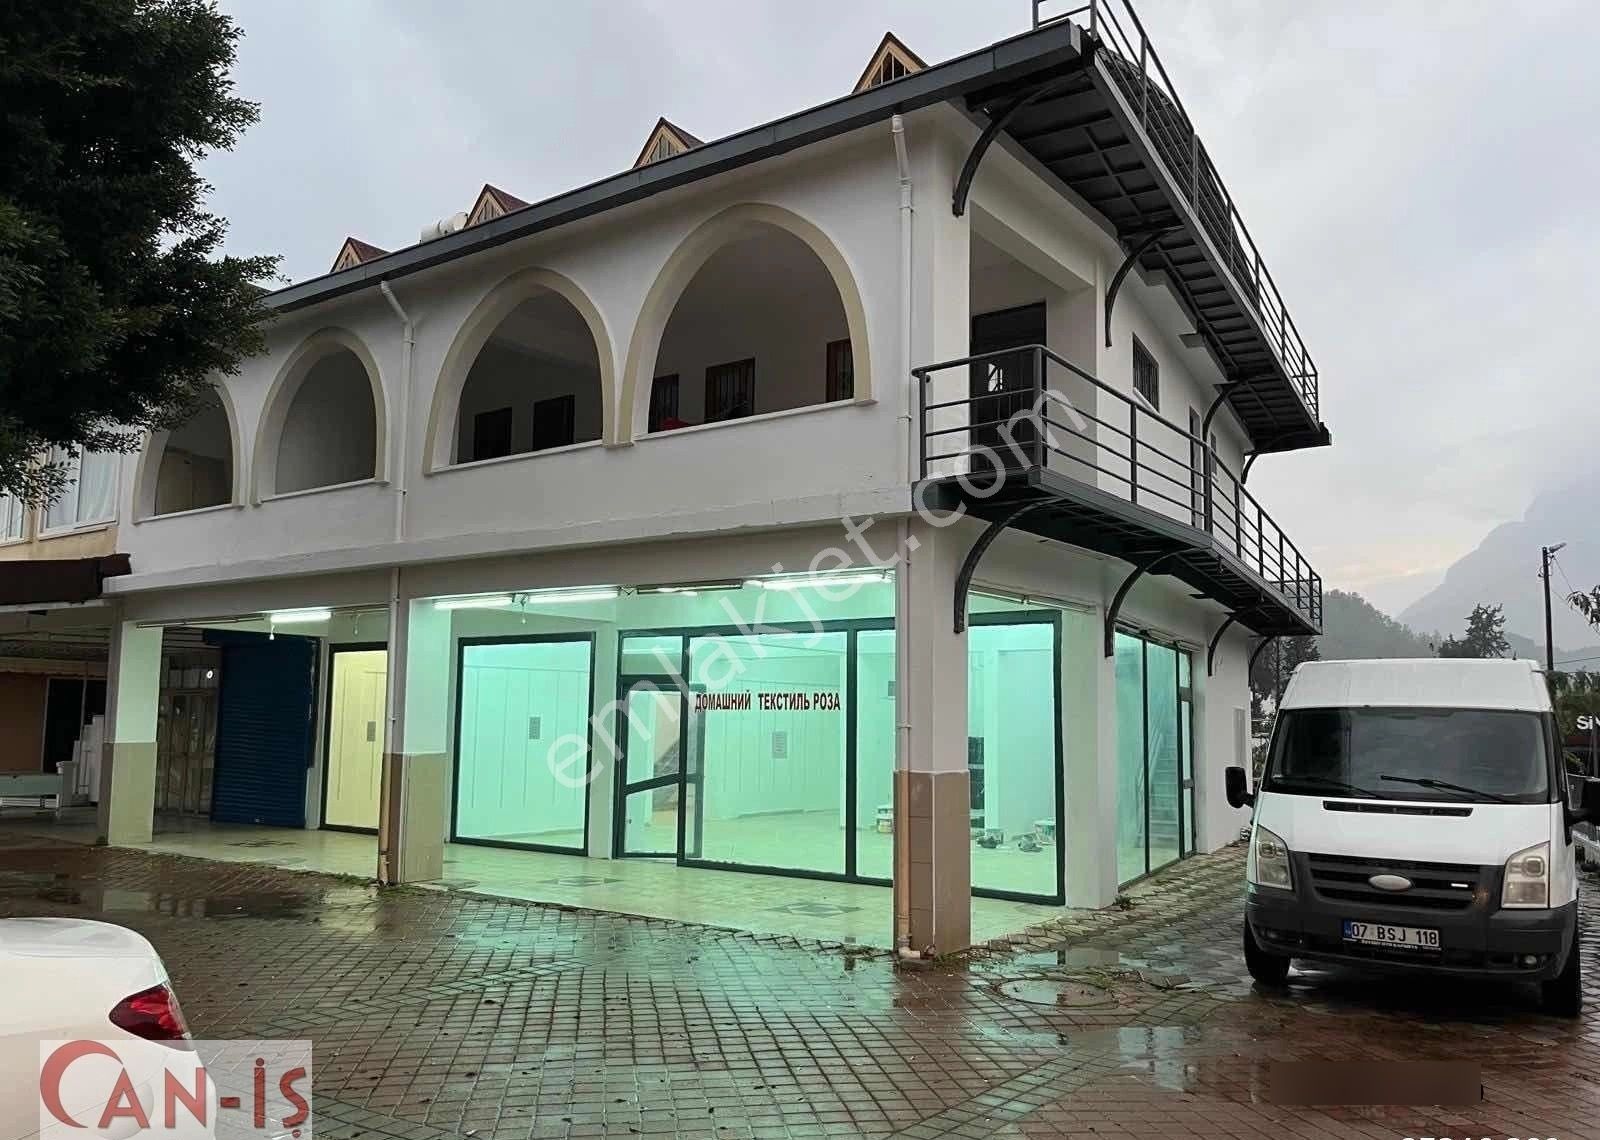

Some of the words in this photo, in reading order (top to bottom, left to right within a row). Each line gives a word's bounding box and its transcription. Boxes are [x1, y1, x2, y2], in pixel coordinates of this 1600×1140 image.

[695, 689, 751, 712] ДОМАШНИЙ
[758, 692, 810, 711] ТЕКСТИЛЬ
[813, 692, 841, 711] РОЗА
[1352, 923, 1368, 938] 07
[1377, 926, 1407, 942] BSJ
[1416, 930, 1437, 945] 118
